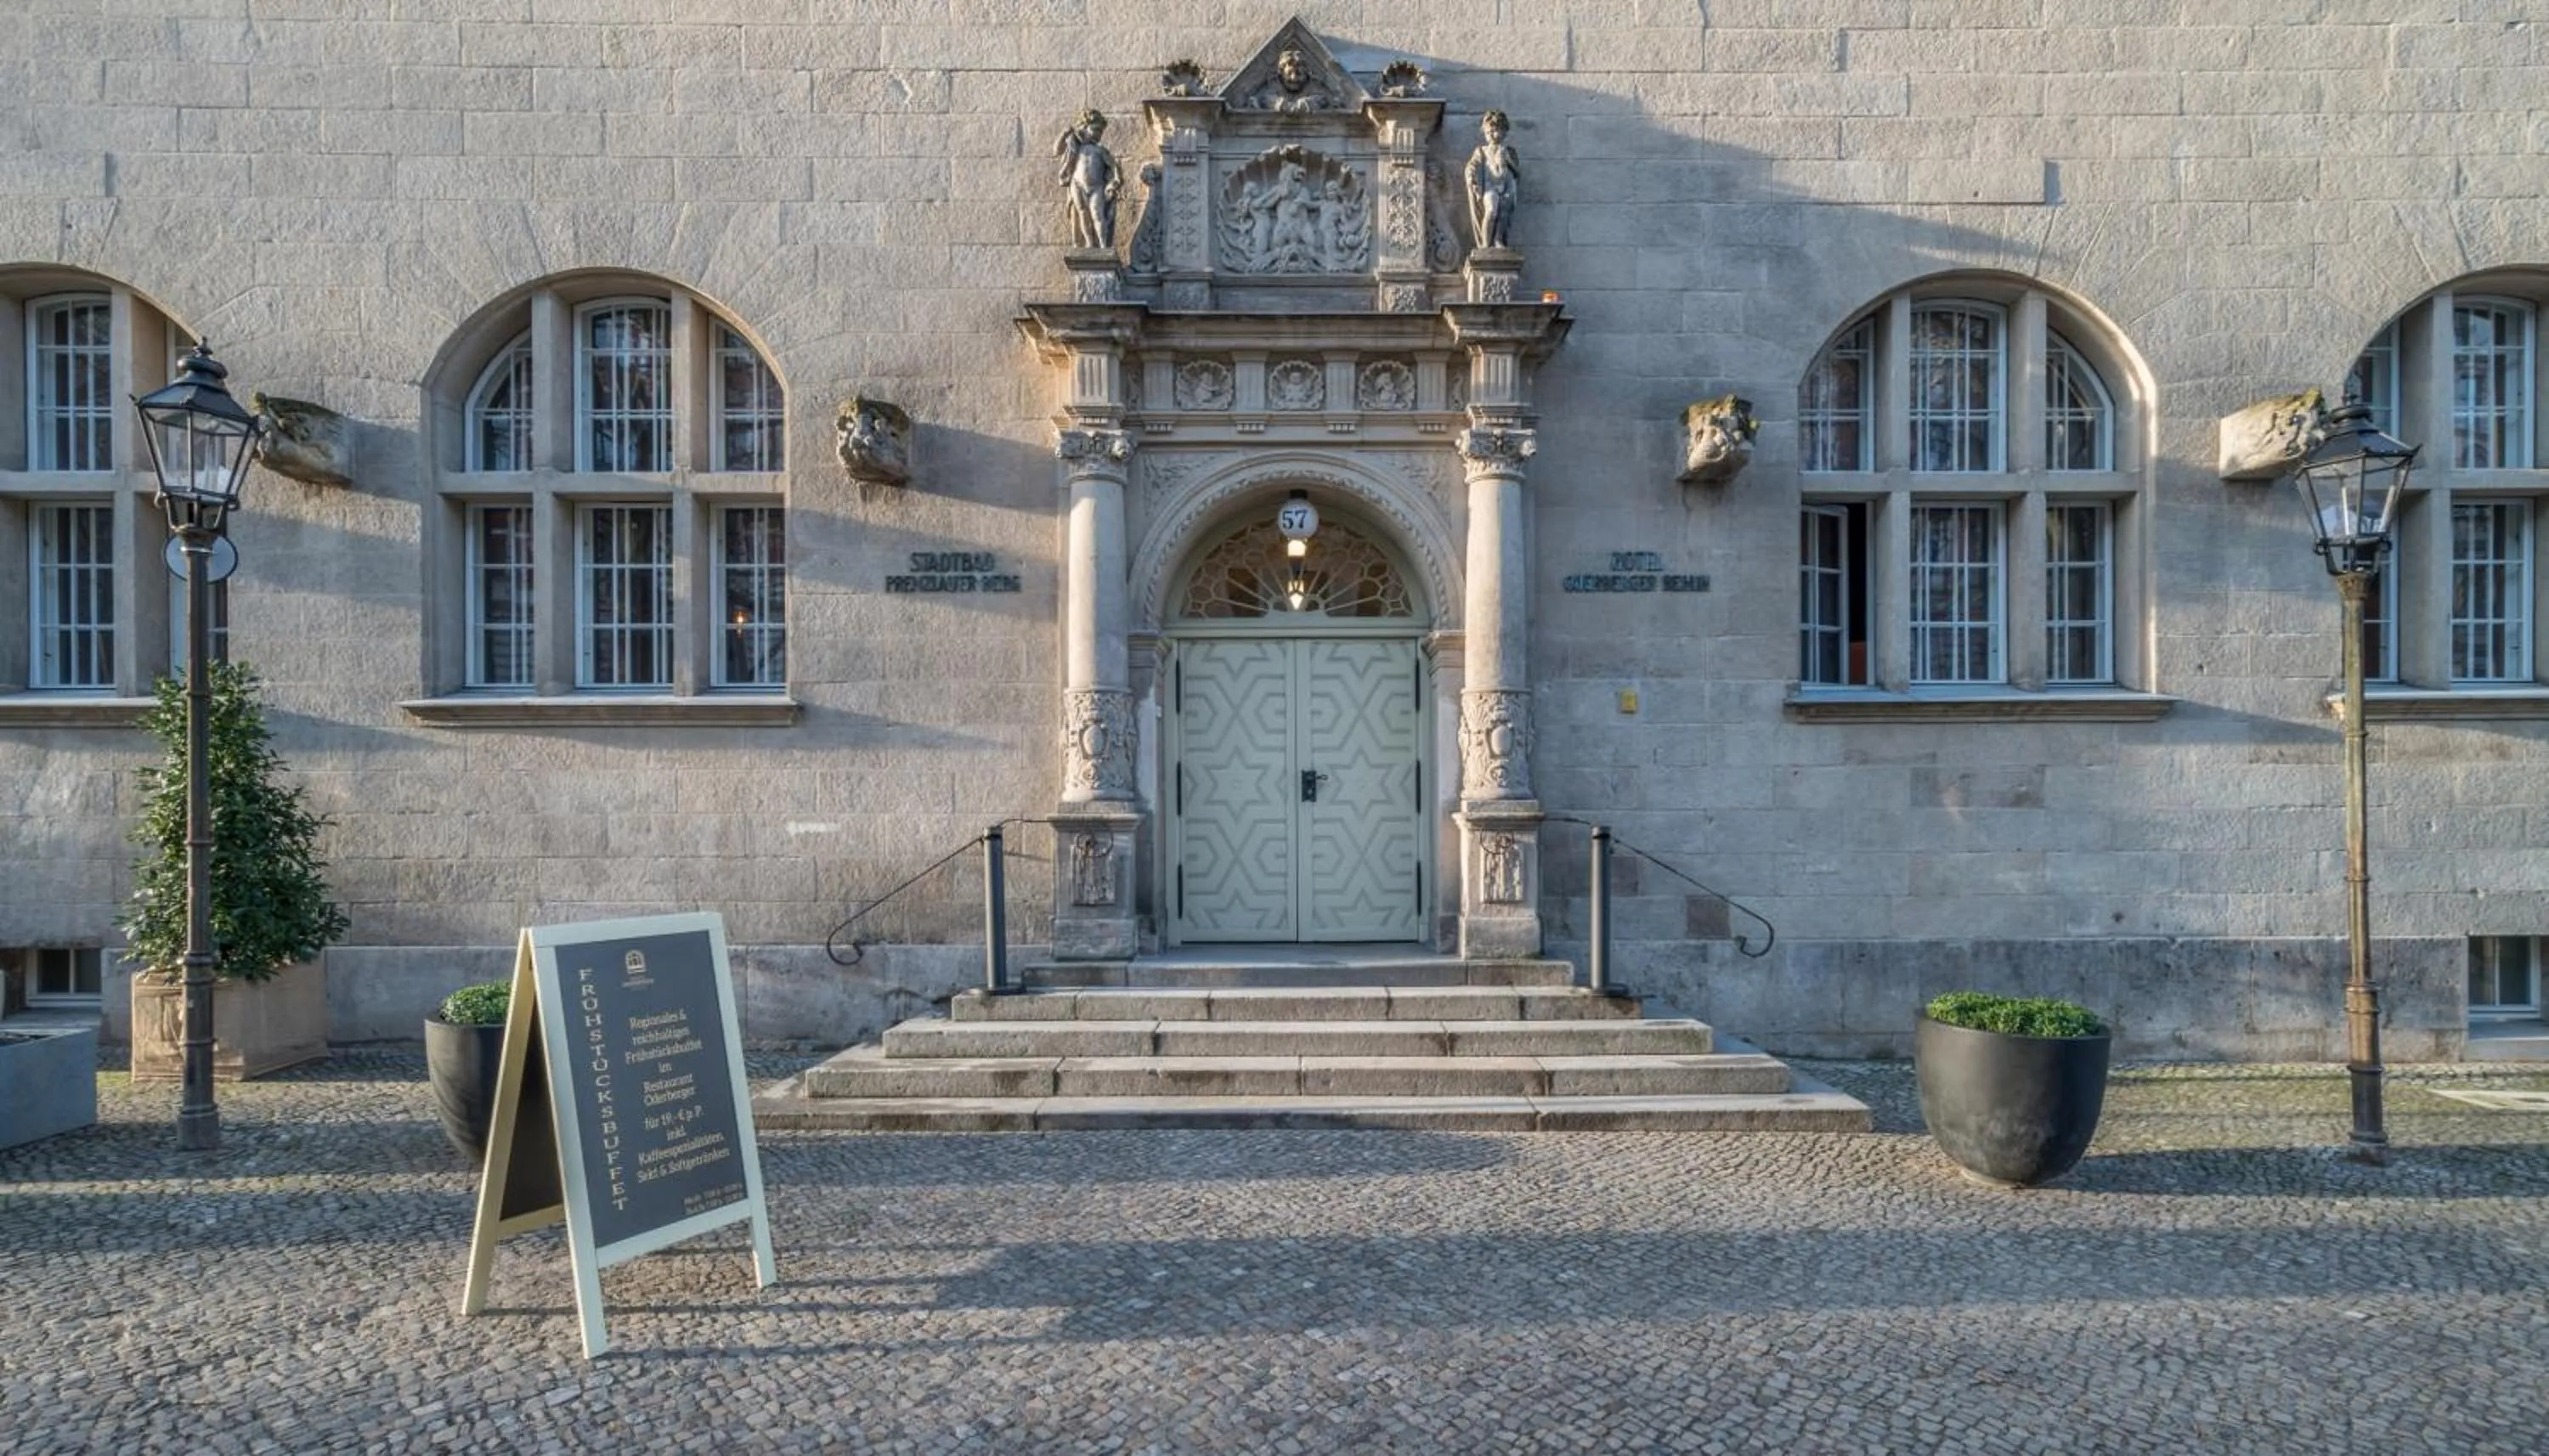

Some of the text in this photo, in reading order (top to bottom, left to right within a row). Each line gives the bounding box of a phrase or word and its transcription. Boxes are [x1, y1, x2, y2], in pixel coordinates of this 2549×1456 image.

[1282, 510, 1307, 529] 57
[910, 552, 995, 573] STADTBAD
[885, 576, 977, 593] PRENZLAUER
[630, 1013, 678, 1030] Regionales
[658, 1062, 672, 1072] im
[643, 1074, 693, 1093] Restaurant
[643, 1087, 696, 1106] Oderberger
[643, 1116, 659, 1130] für
